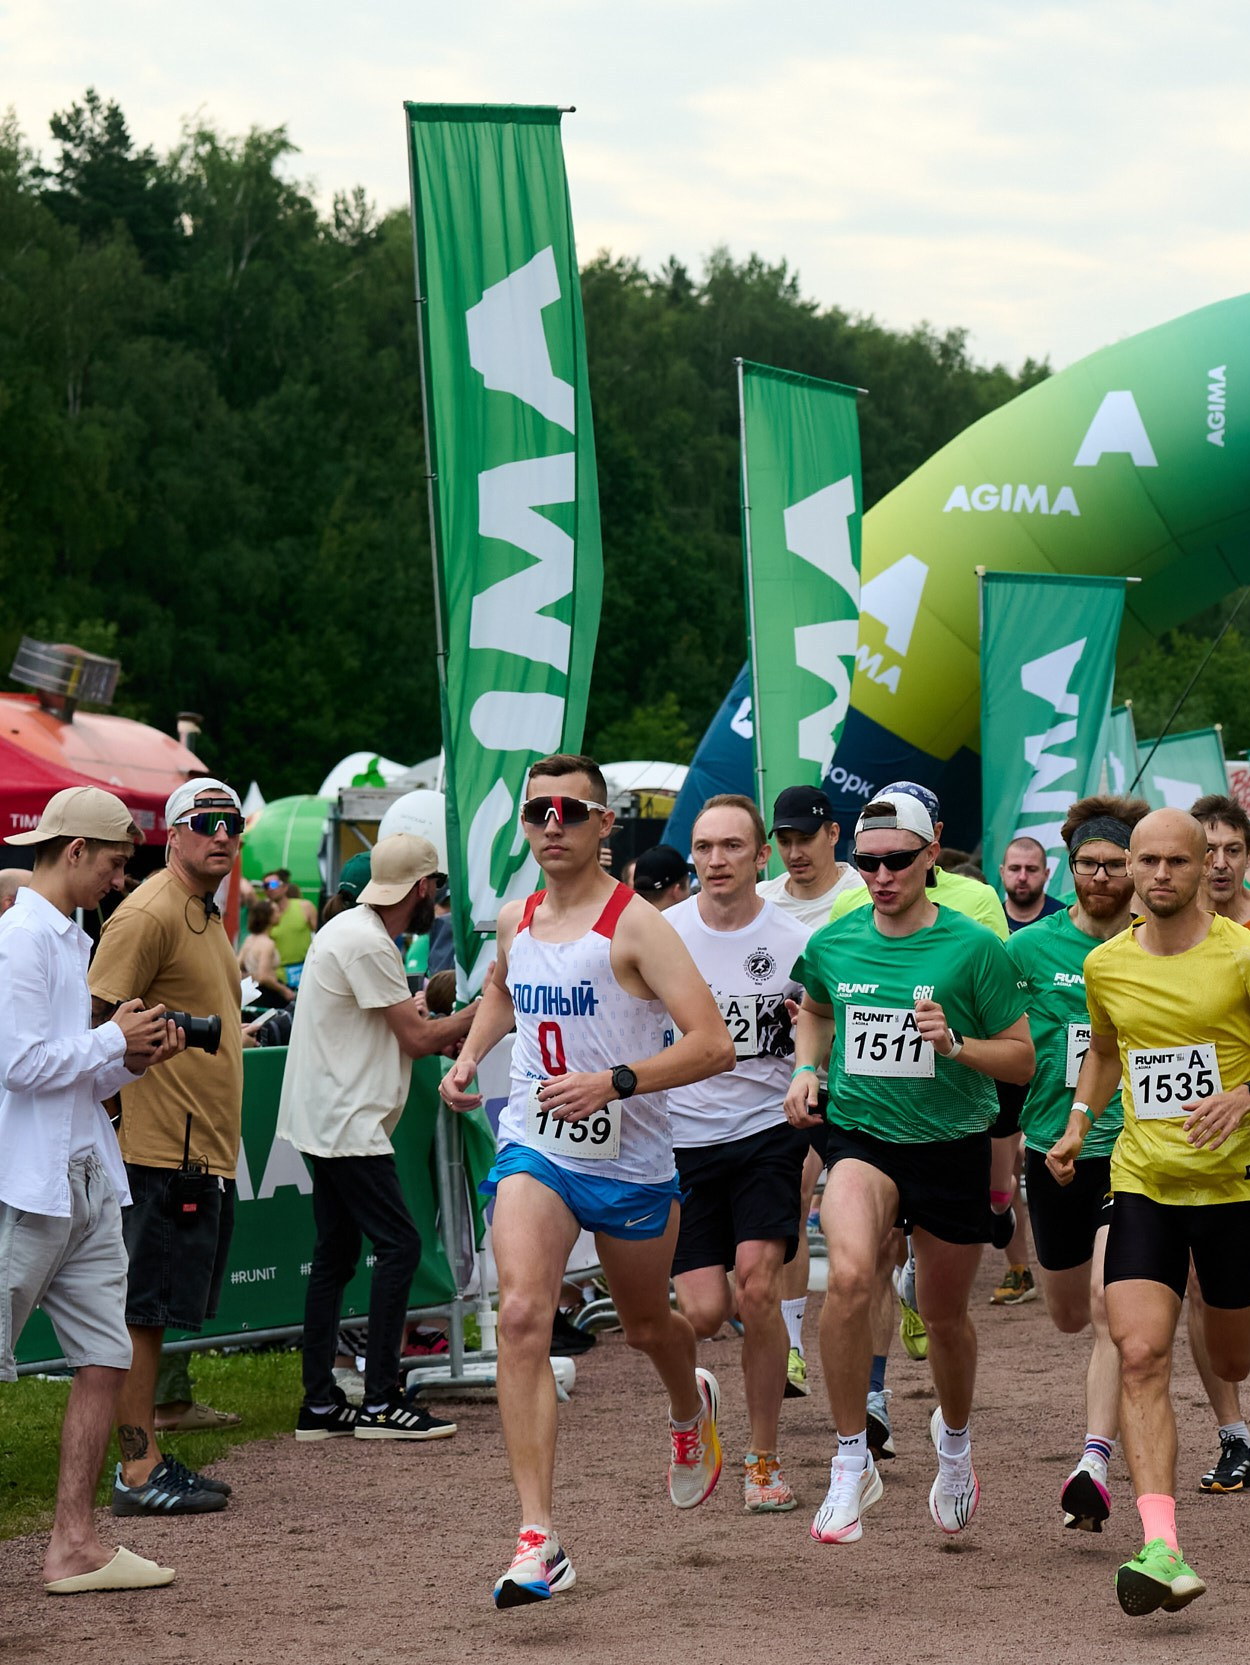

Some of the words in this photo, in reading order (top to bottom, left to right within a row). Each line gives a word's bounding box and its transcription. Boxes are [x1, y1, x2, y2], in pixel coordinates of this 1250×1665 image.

[1206, 365, 1227, 448] AGIMA
[1073, 390, 1159, 467] A
[942, 484, 1081, 516] AGIMA
[828, 762, 875, 799] орк
[837, 982, 880, 994] RUNIT
[726, 1001, 742, 1017] A
[852, 1012, 894, 1023] RUNIT
[901, 1012, 918, 1032] A
[854, 1031, 923, 1062] 1511
[1135, 1054, 1175, 1065] RUNIT
[1188, 1049, 1206, 1069] A
[1139, 1070, 1214, 1104] 1535
[230, 1266, 277, 1285] #RUNIT
